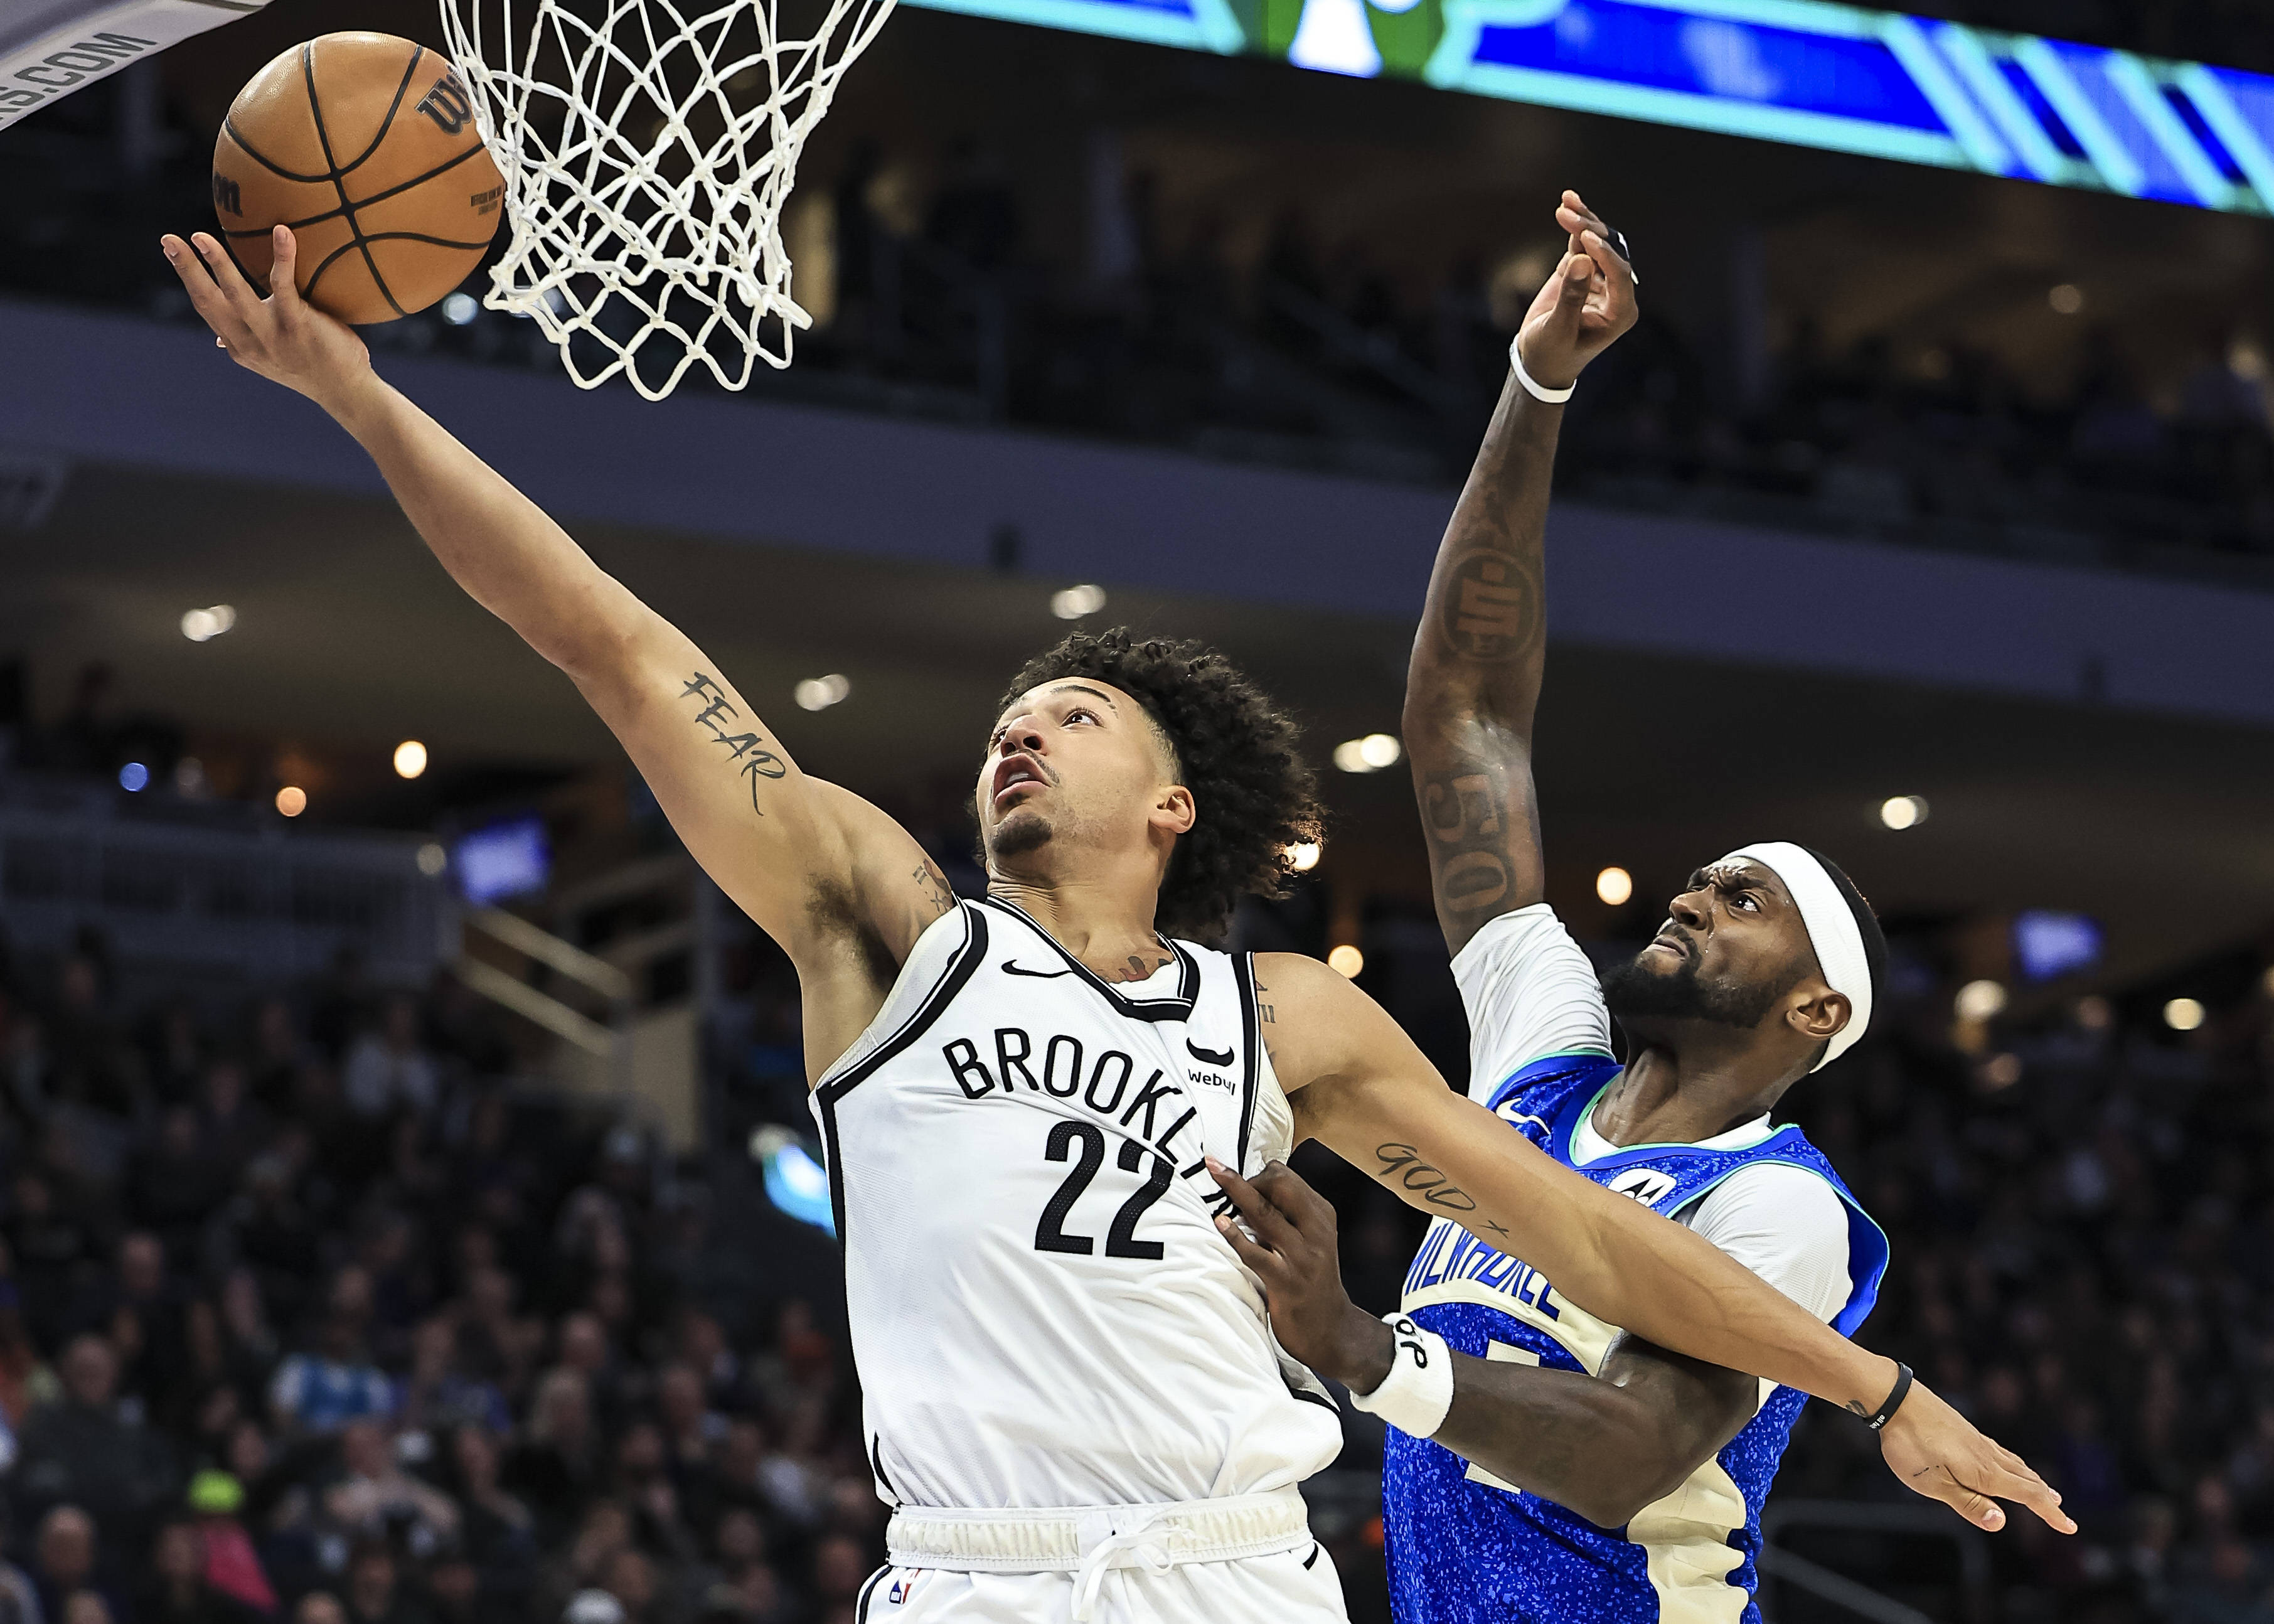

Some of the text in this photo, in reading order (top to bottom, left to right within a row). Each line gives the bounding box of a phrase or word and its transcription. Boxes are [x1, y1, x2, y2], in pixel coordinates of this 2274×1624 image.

[680, 671, 786, 816] FEAR
[1035, 1120, 1175, 1260] 22
[1376, 1143, 1476, 1211] GOD
